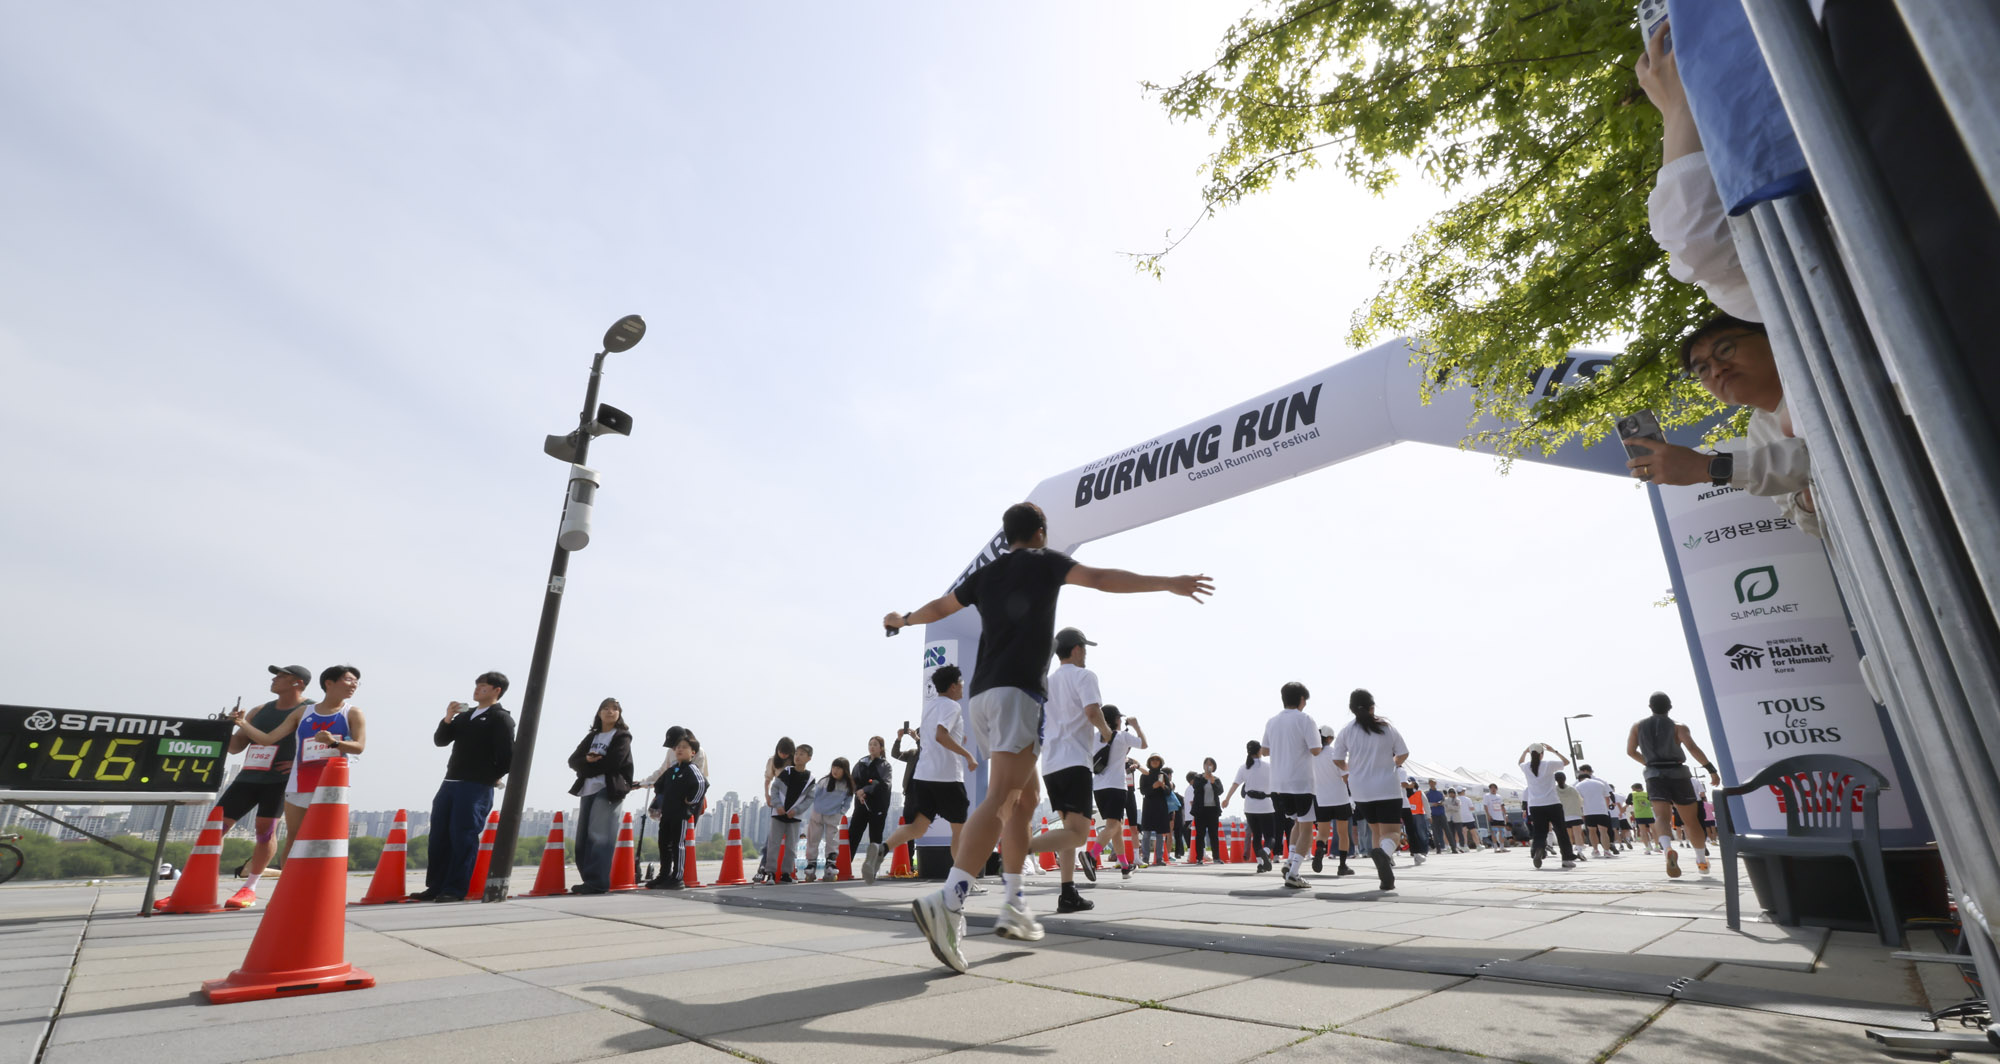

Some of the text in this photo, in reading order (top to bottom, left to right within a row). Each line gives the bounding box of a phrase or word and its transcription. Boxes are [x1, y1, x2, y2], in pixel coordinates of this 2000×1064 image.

[1075, 383, 1323, 508] BURNING RUN
[1187, 427, 1321, 482] Casual Running Festival
[1704, 517, 1797, 544] 김정문알로
[1730, 603, 1799, 621] SLIMPLANET
[1768, 643, 1830, 659] Habitat
[1772, 658, 1786, 666] for
[1757, 696, 1825, 715] TOUS
[60, 713, 183, 737] SAMIK
[1785, 713, 1807, 729] les
[168, 740, 213, 755] 10km
[1763, 727, 1842, 750] JOURS
